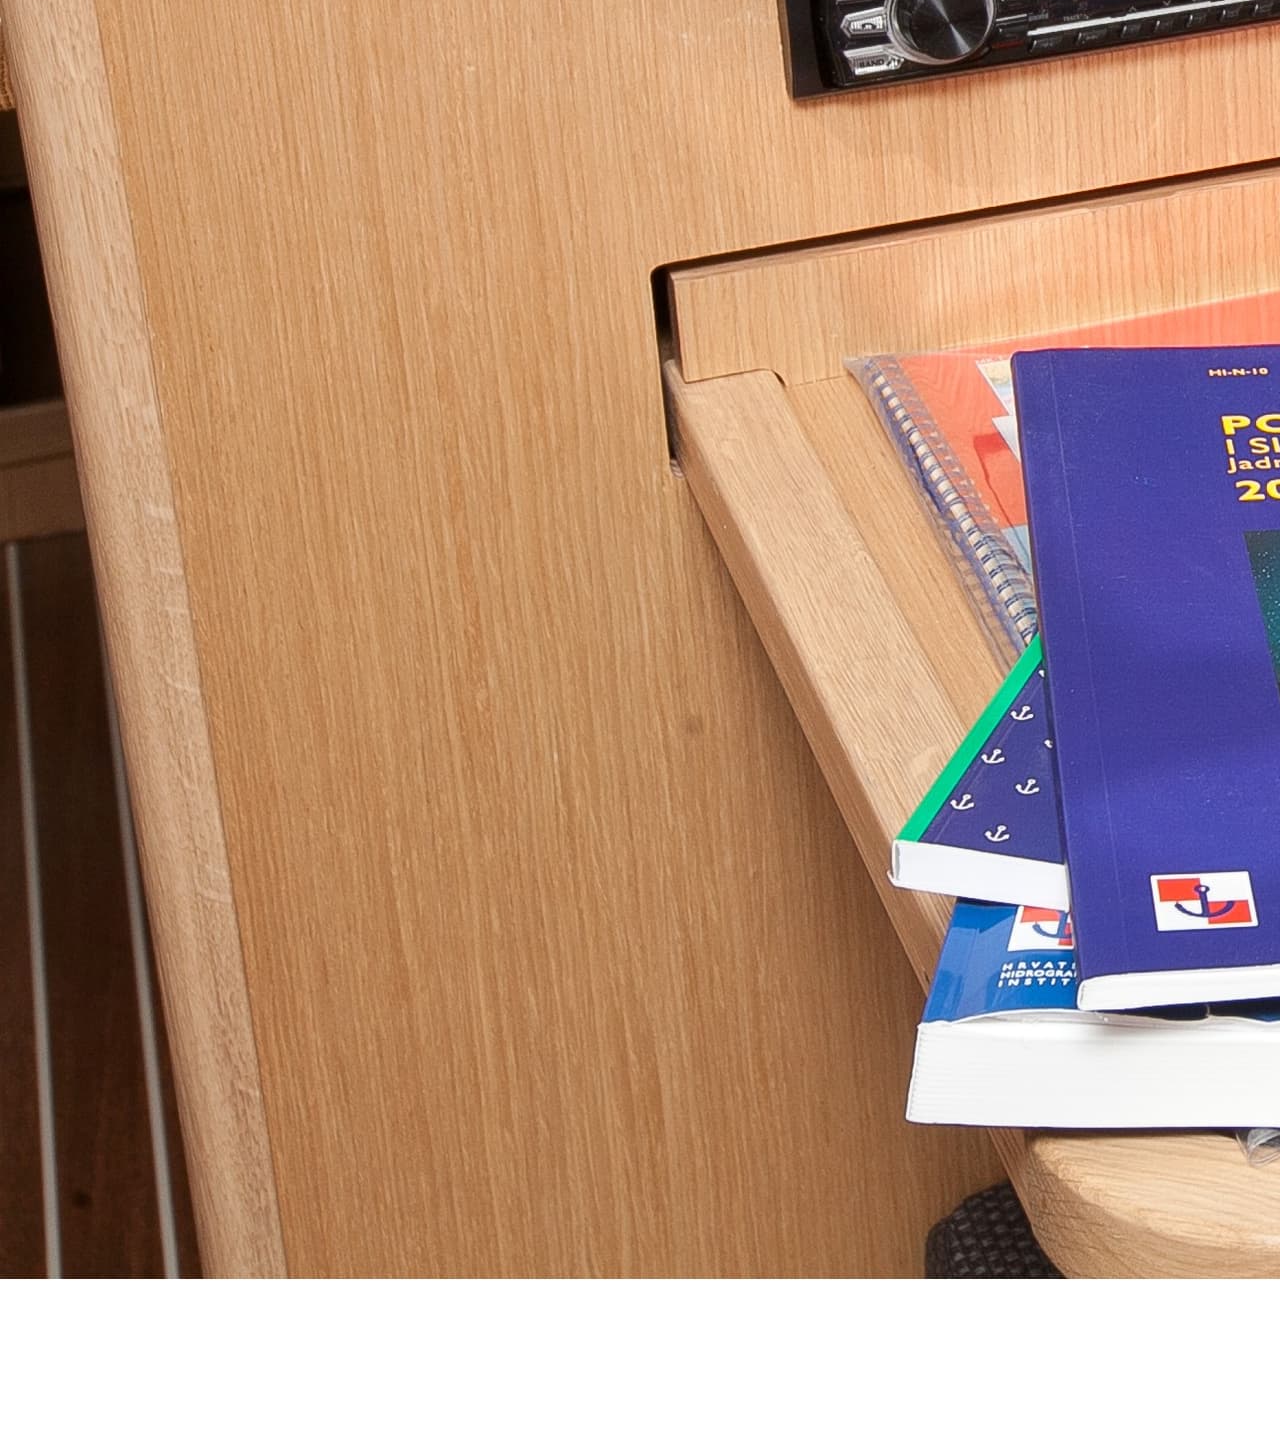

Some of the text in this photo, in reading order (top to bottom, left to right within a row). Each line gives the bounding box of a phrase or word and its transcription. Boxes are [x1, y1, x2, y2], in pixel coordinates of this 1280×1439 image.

[1209, 368, 1268, 377] HI-N-10
[1226, 439, 1236, 455] I
[998, 978, 1071, 987] INSTIT
